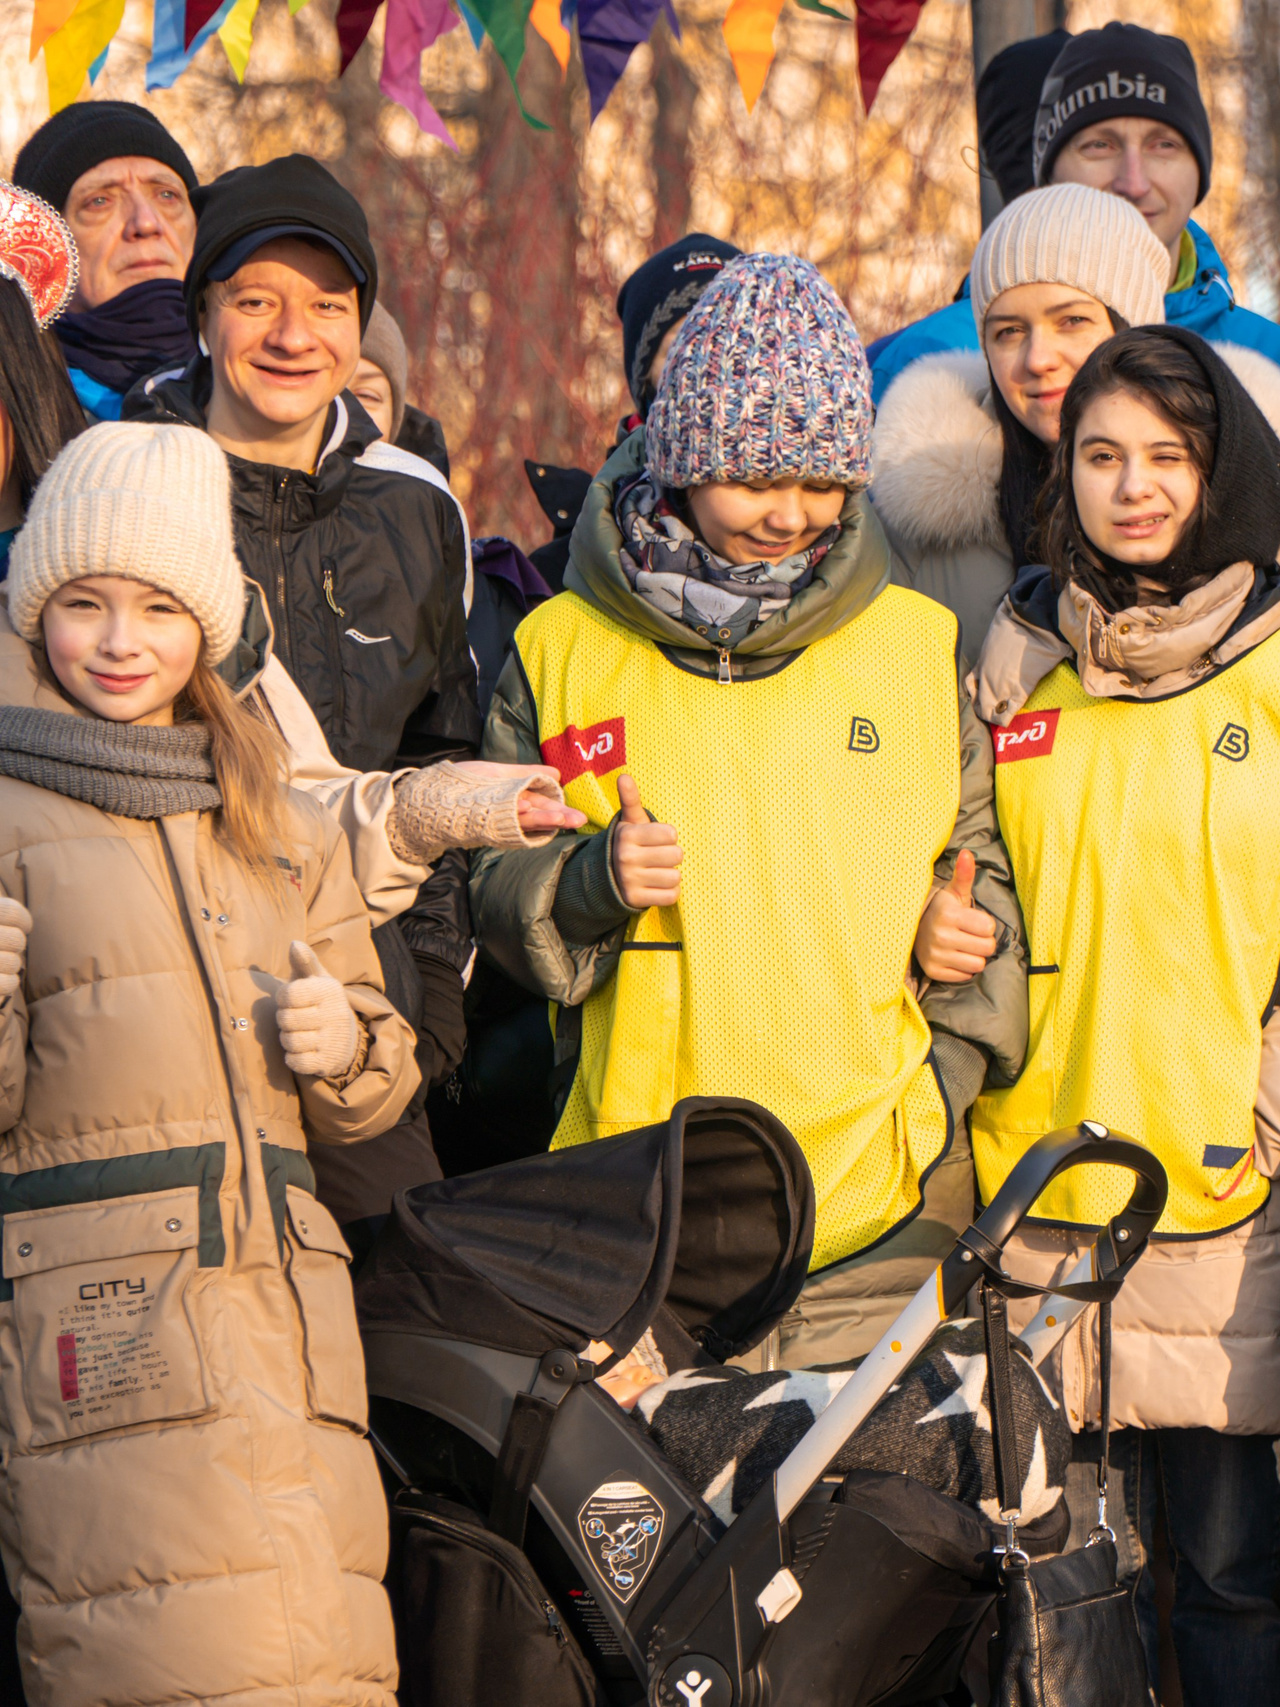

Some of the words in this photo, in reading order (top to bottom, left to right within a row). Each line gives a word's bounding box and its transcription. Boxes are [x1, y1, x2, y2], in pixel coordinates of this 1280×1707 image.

[1037, 70, 1167, 156] Columbia
[79, 1277, 146, 1300] CITY
[74, 1304, 96, 1314] like
[116, 1299, 137, 1307] town
[141, 1294, 155, 1303] and
[70, 1315, 95, 1324] think
[101, 1311, 122, 1319] it's
[127, 1305, 151, 1317] quite
[75, 1336, 86, 1344] my
[138, 1331, 153, 1339] his
[92, 1352, 113, 1363] just
[118, 1343, 150, 1357] because
[78, 1365, 99, 1376] gave
[140, 1350, 161, 1360] best
[108, 1368, 127, 1378] life
[141, 1360, 168, 1370] hours
[66, 1400, 81, 1408] not
[85, 1396, 96, 1404] an
[100, 1386, 145, 1401] exception
[150, 1383, 161, 1391] as
[89, 1384, 104, 1393] his
[68, 1410, 83, 1420] you
